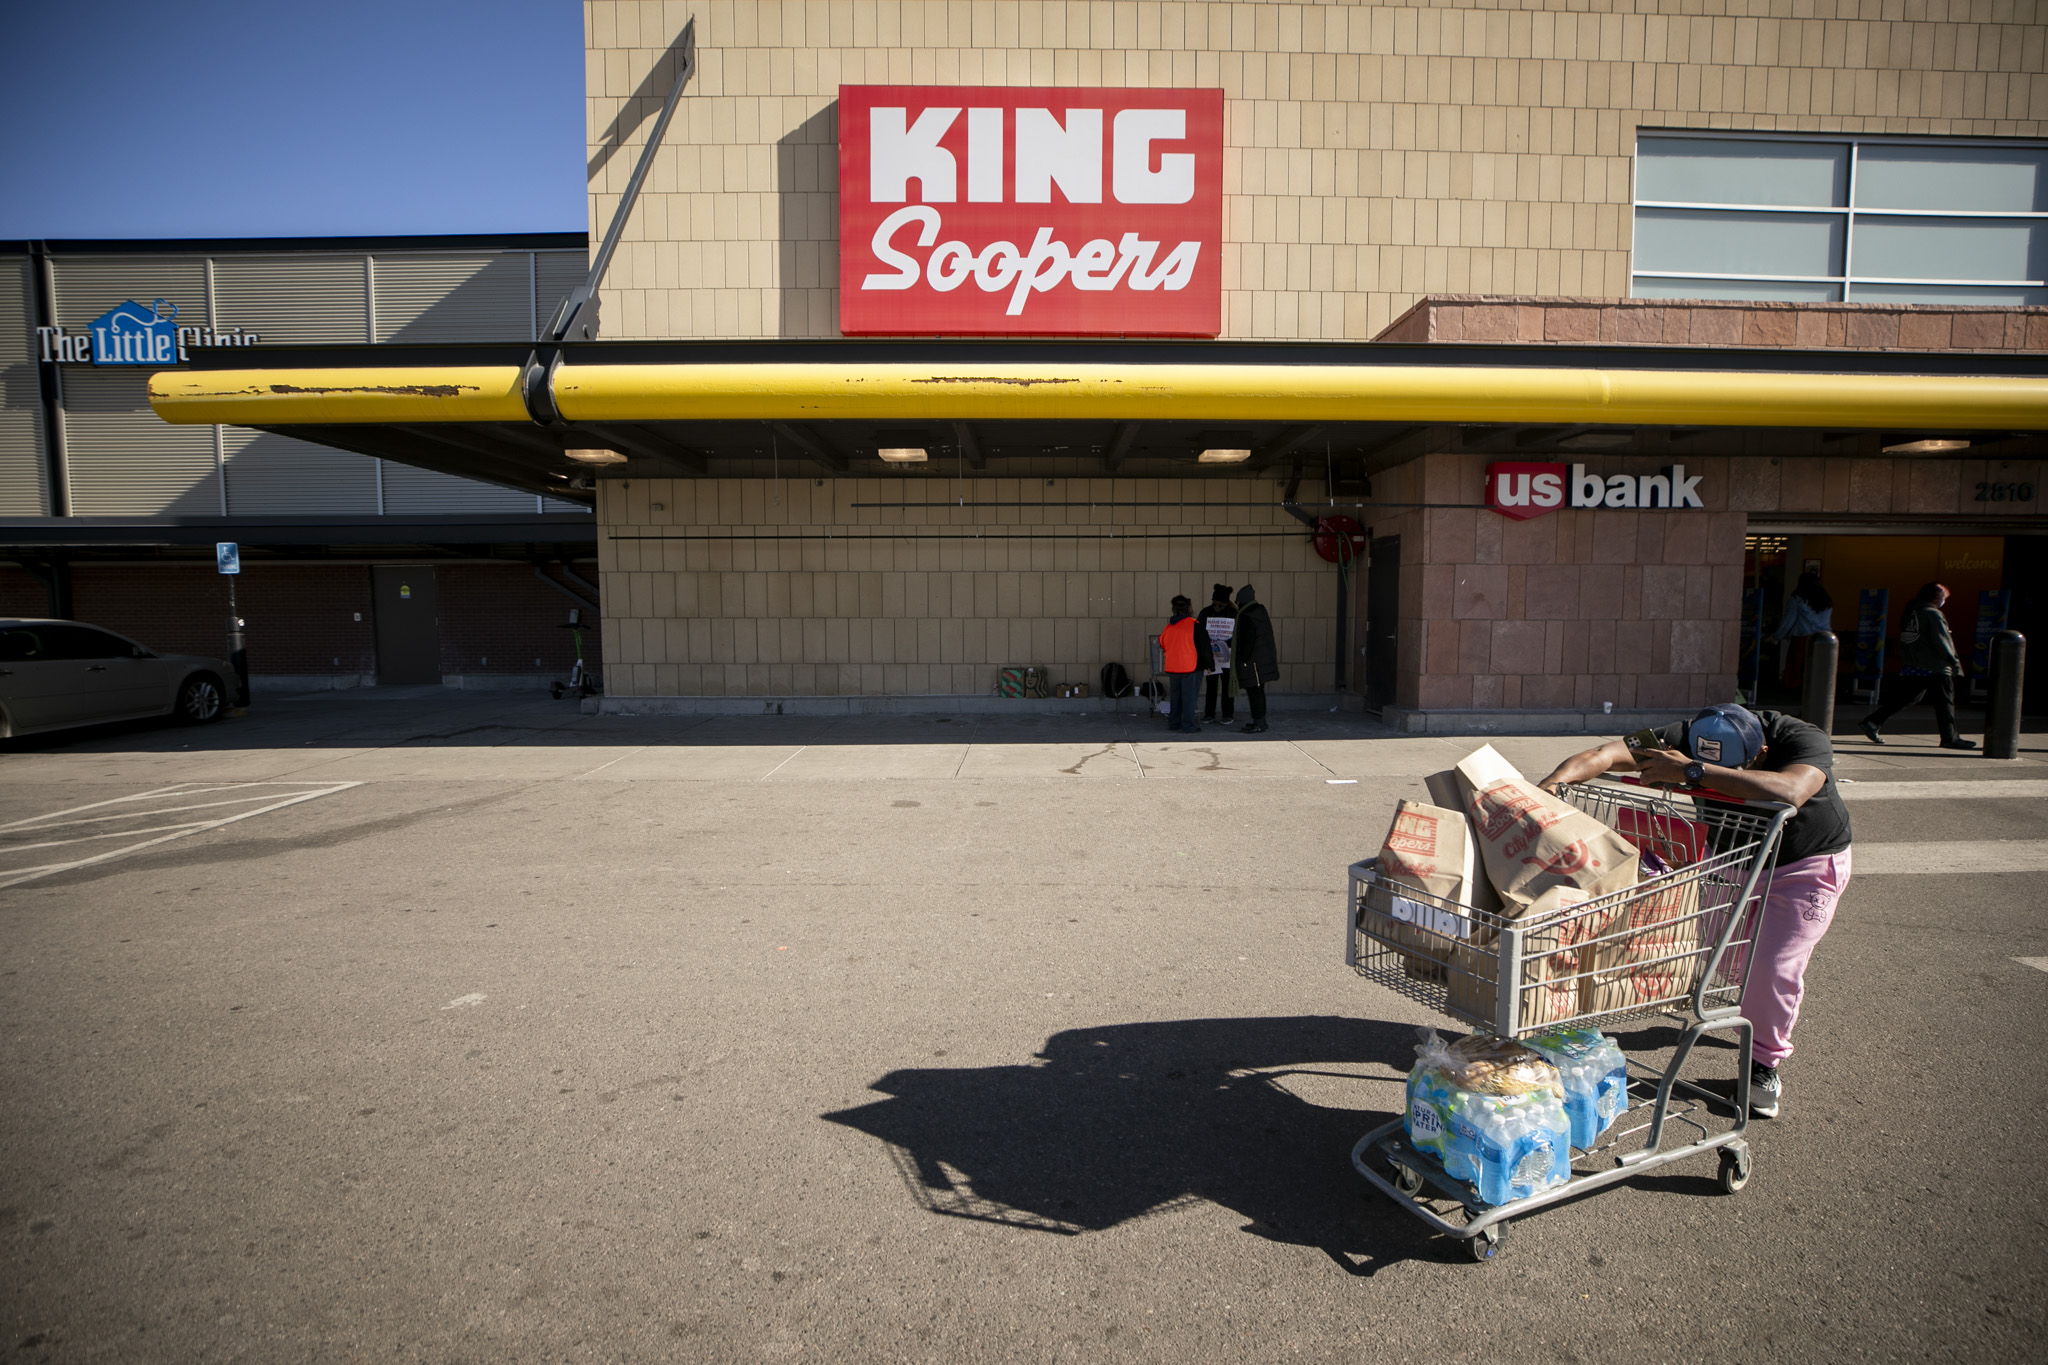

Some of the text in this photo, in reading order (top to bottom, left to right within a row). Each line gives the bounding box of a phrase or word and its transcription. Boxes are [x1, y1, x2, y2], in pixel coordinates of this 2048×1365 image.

[870, 107, 1195, 204] KING
[861, 205, 1201, 315] Soopers
[36, 327, 90, 362] The
[96, 327, 171, 362] Little
[1498, 463, 1704, 508] us bank
[1975, 482, 2034, 502] 2810
[1944, 552, 2000, 569] welcome
[1395, 815, 1431, 837] ING
[1413, 1104, 1440, 1121] ATURAL
[1413, 1110, 1446, 1133] PRIN
